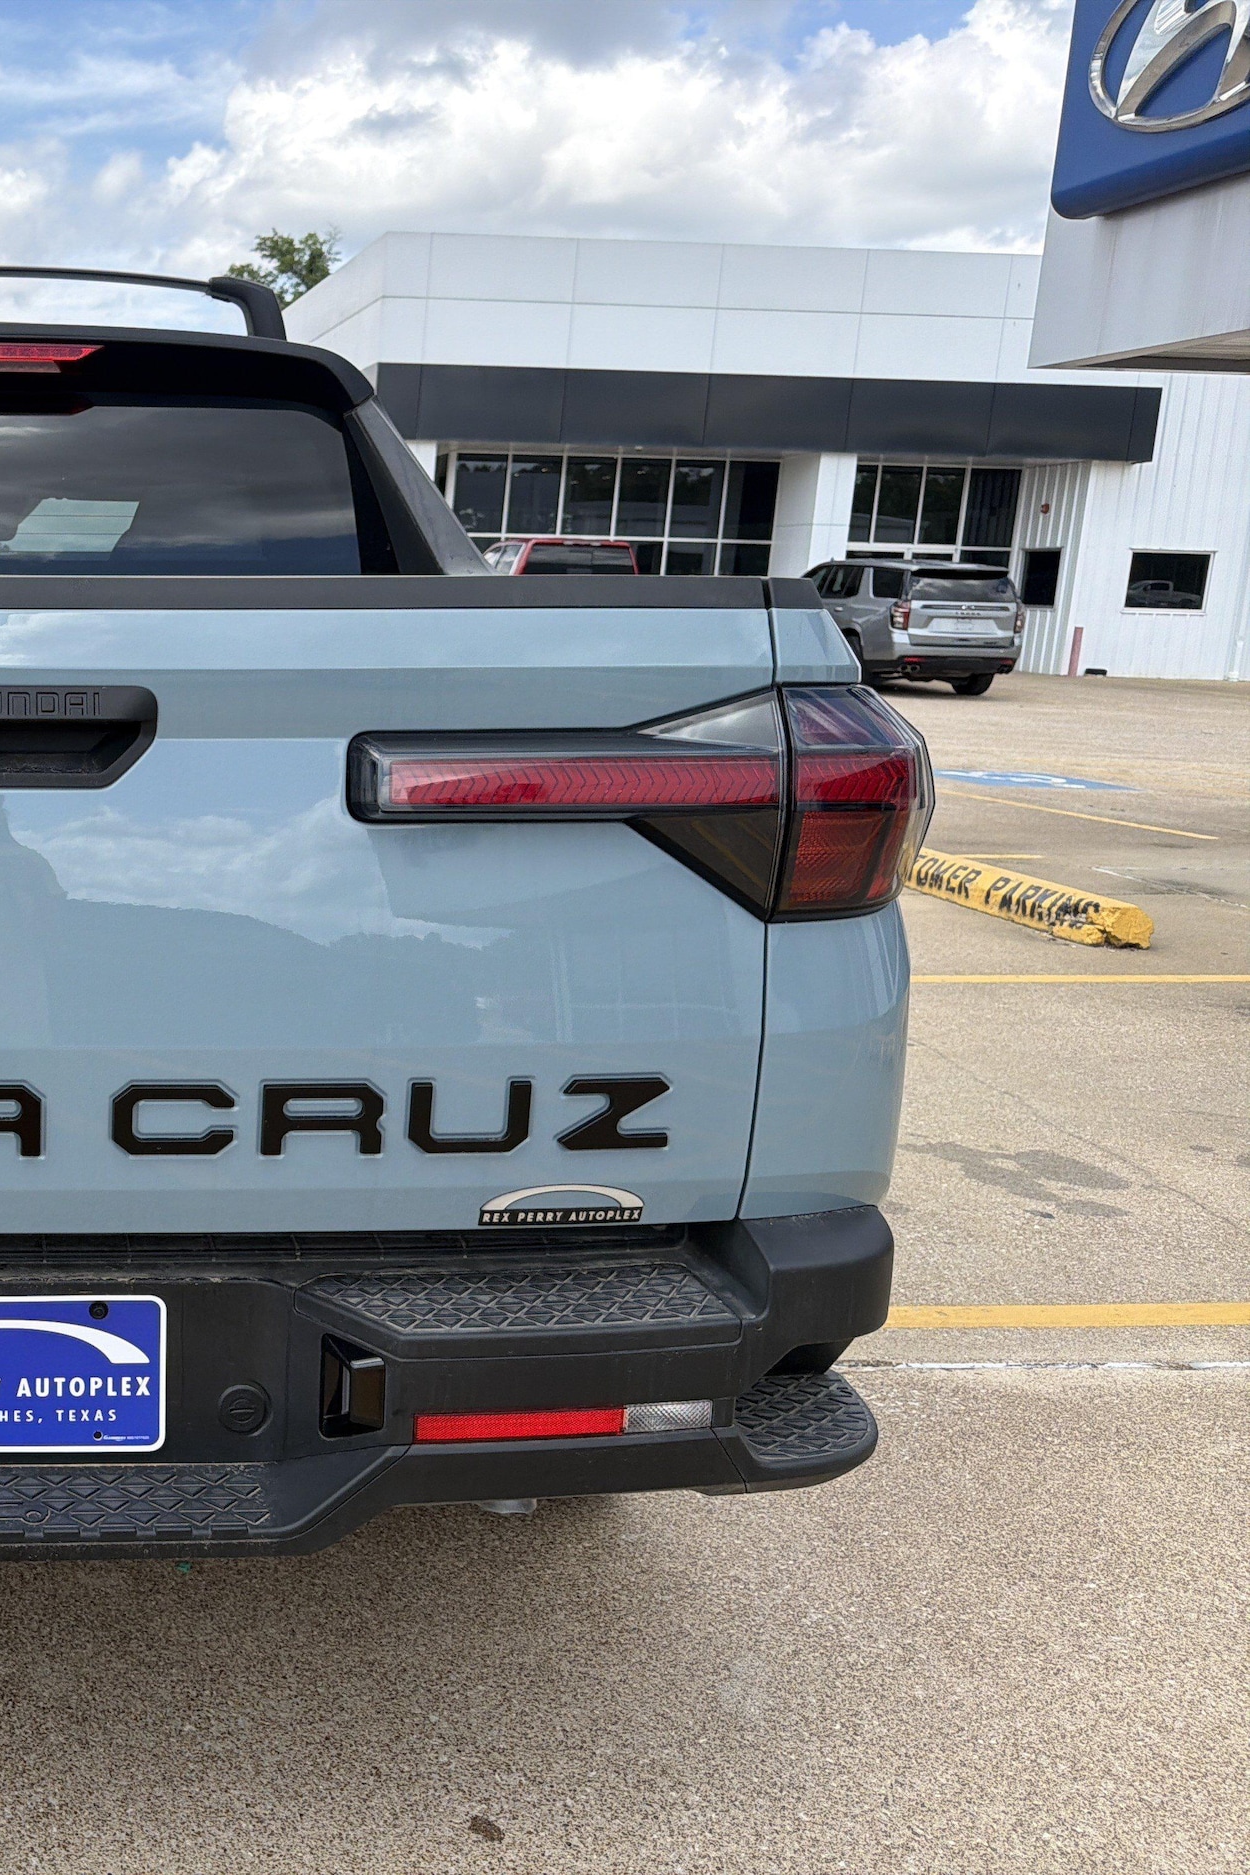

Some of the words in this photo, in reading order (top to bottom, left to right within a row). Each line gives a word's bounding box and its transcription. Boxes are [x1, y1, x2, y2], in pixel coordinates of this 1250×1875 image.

[110, 1075, 671, 1157] CRUZ
[482, 1212, 510, 1223] REX
[517, 1211, 564, 1222] PERRY
[568, 1209, 641, 1221] AUTOPLEX
[16, 1376, 150, 1397] AUTOPLEX
[56, 1409, 117, 1422] TEXAS
